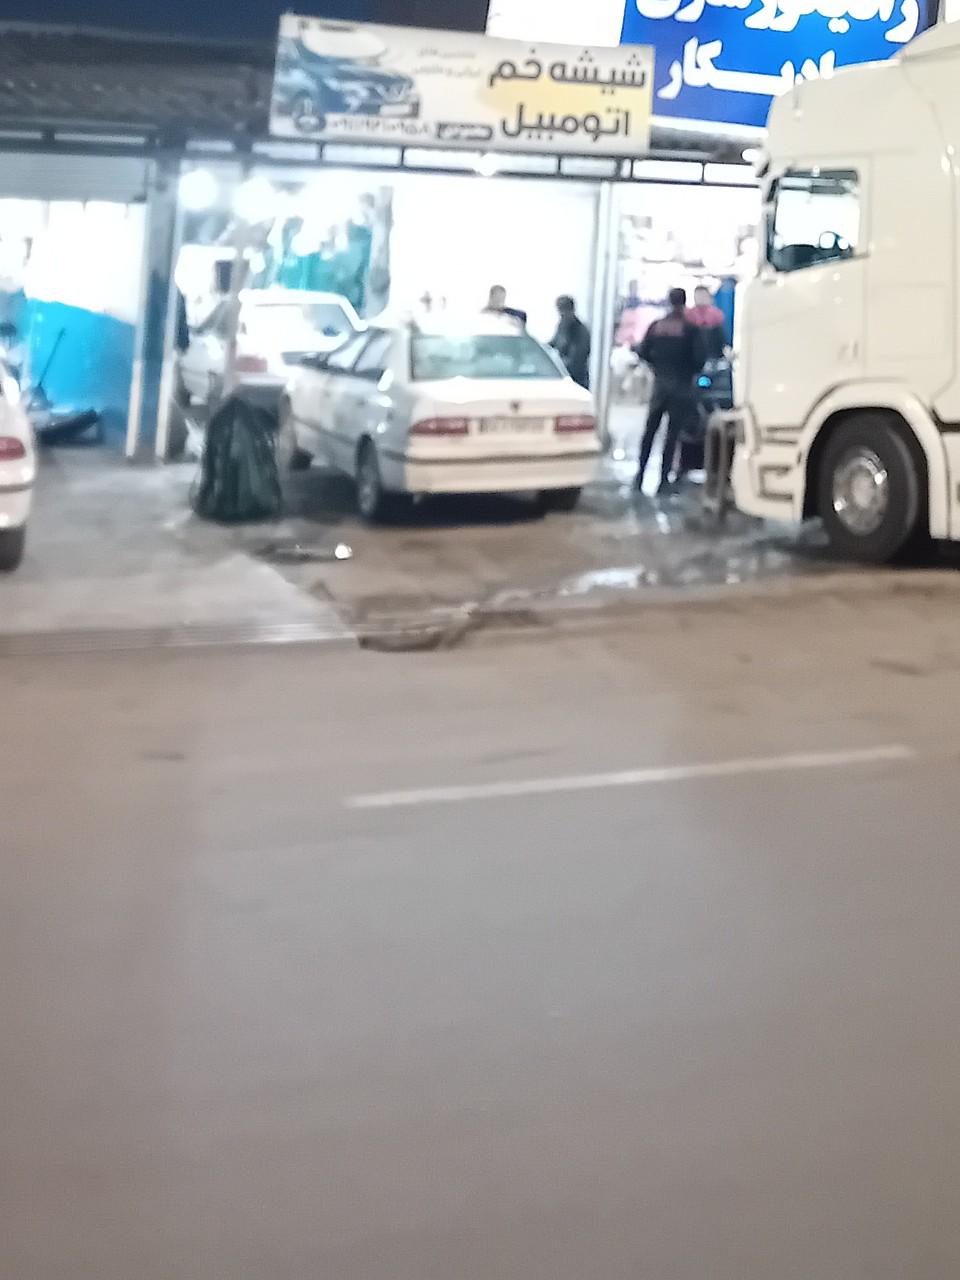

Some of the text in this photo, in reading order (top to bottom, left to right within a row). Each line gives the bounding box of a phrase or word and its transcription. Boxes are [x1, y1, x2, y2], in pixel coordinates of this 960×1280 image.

[488, 48, 646, 95] شیشه خم
[501, 102, 630, 142] اتومبیل
